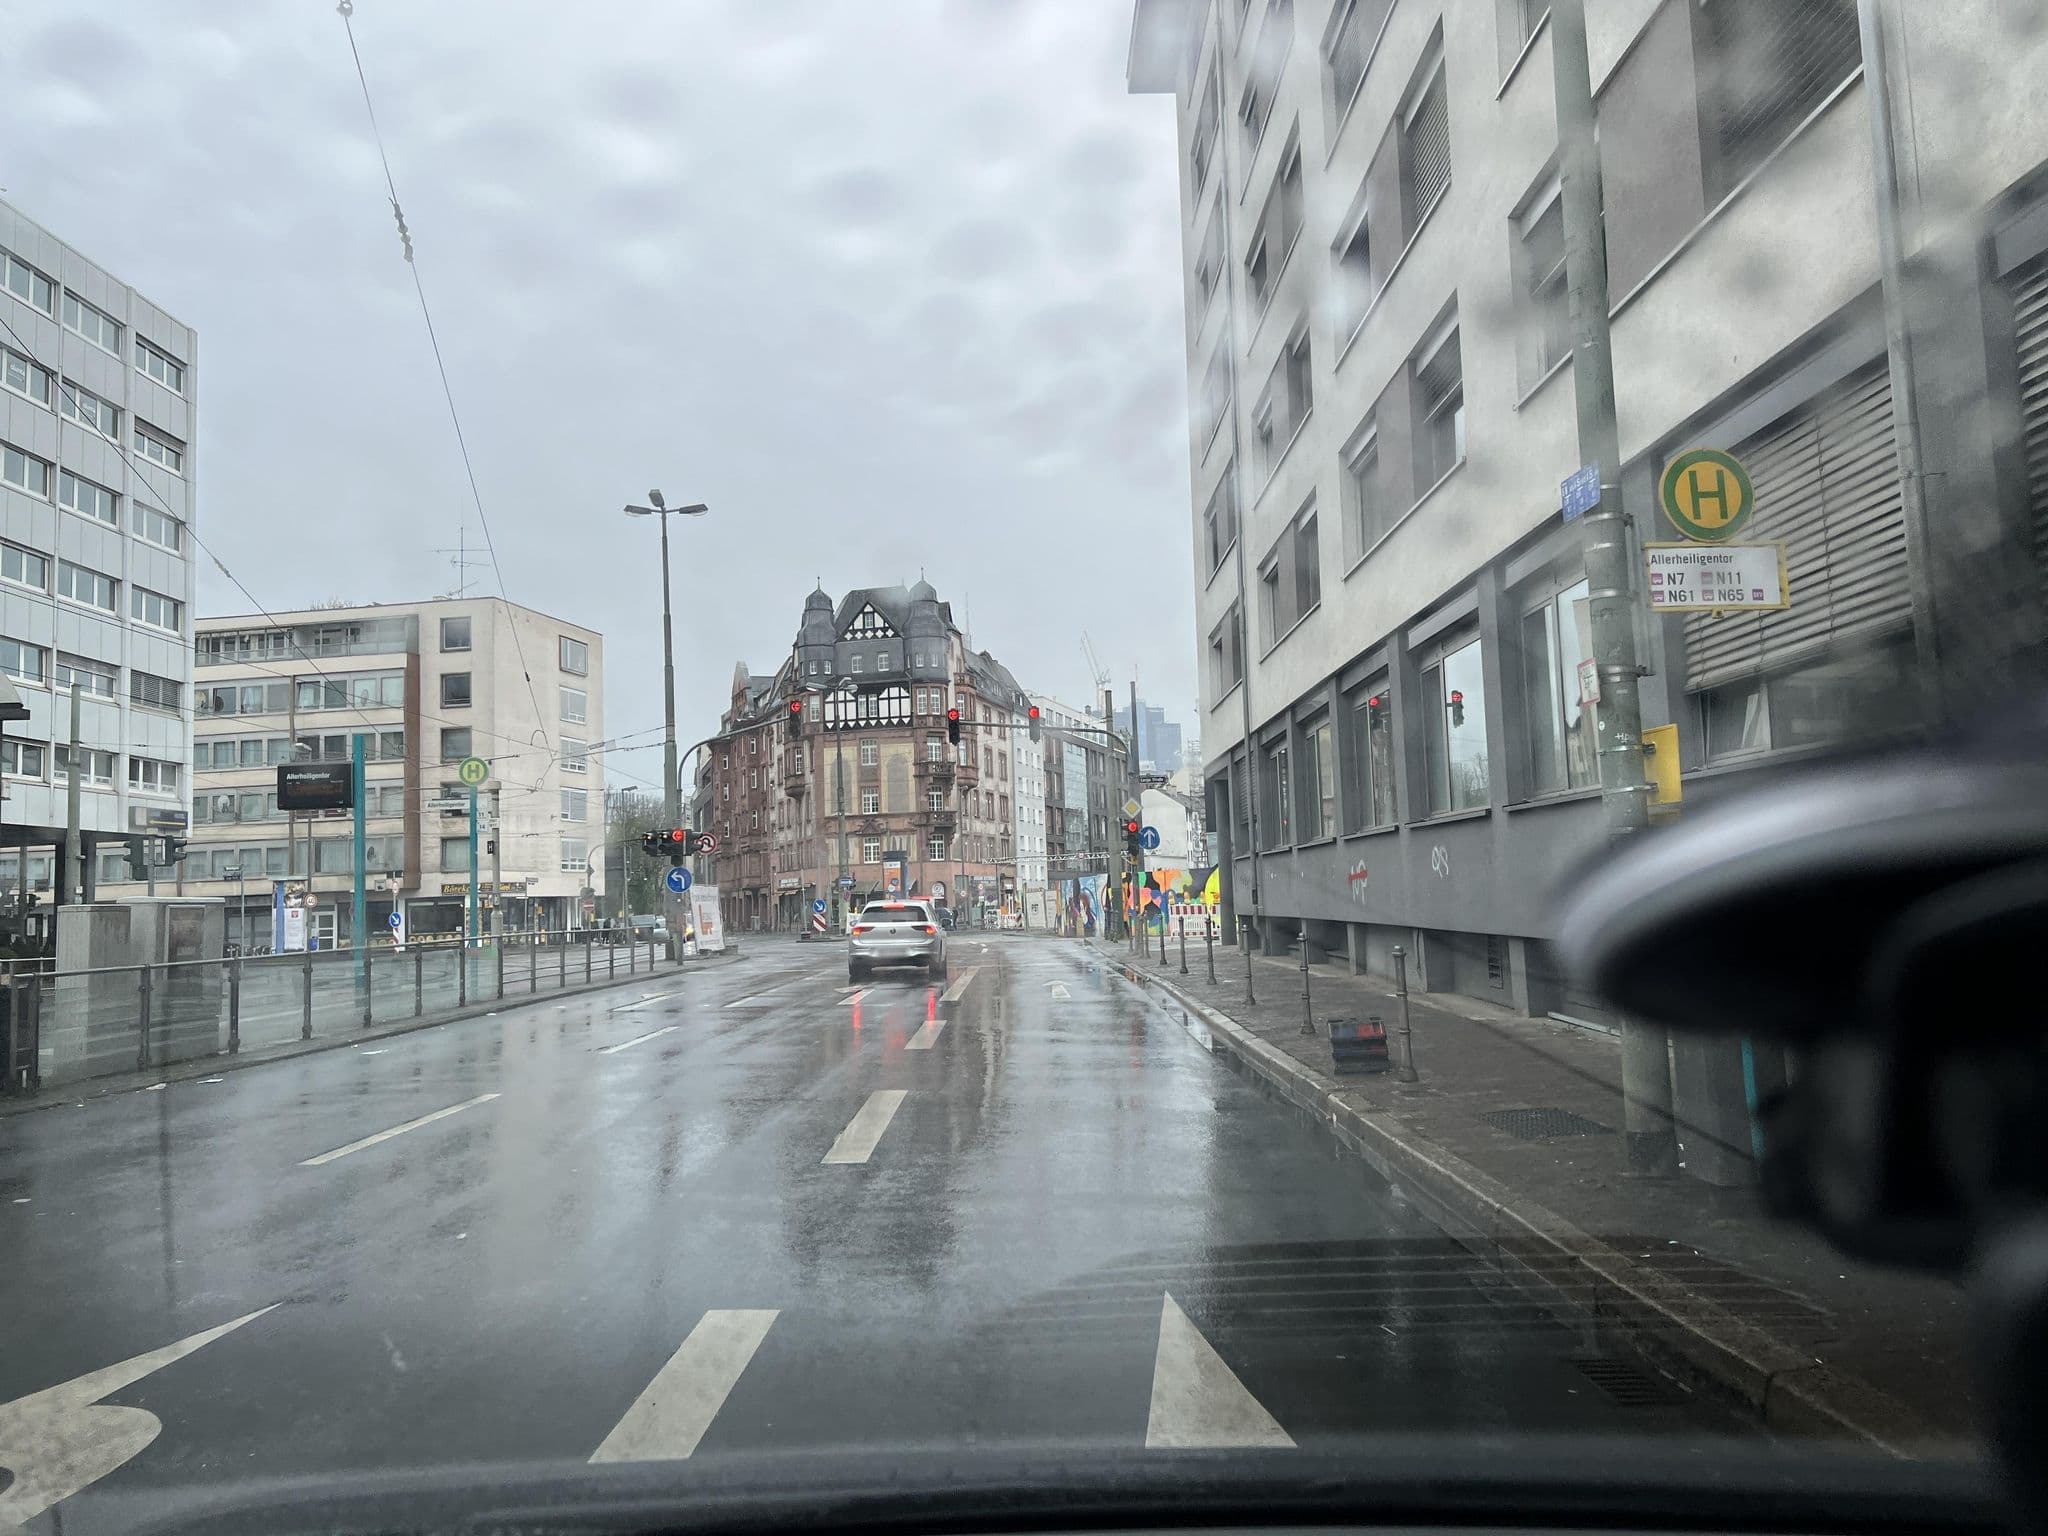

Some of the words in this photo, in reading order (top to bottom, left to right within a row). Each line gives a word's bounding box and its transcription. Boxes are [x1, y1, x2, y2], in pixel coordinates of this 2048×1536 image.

[1688, 470, 1729, 520] H
[1650, 554, 1734, 566] Allerheiligentor
[1667, 572, 1685, 585] N7
[1716, 571, 1741, 584] N11
[1668, 589, 1694, 602] N61
[1718, 588, 1745, 601] N65
[467, 764, 480, 779] H
